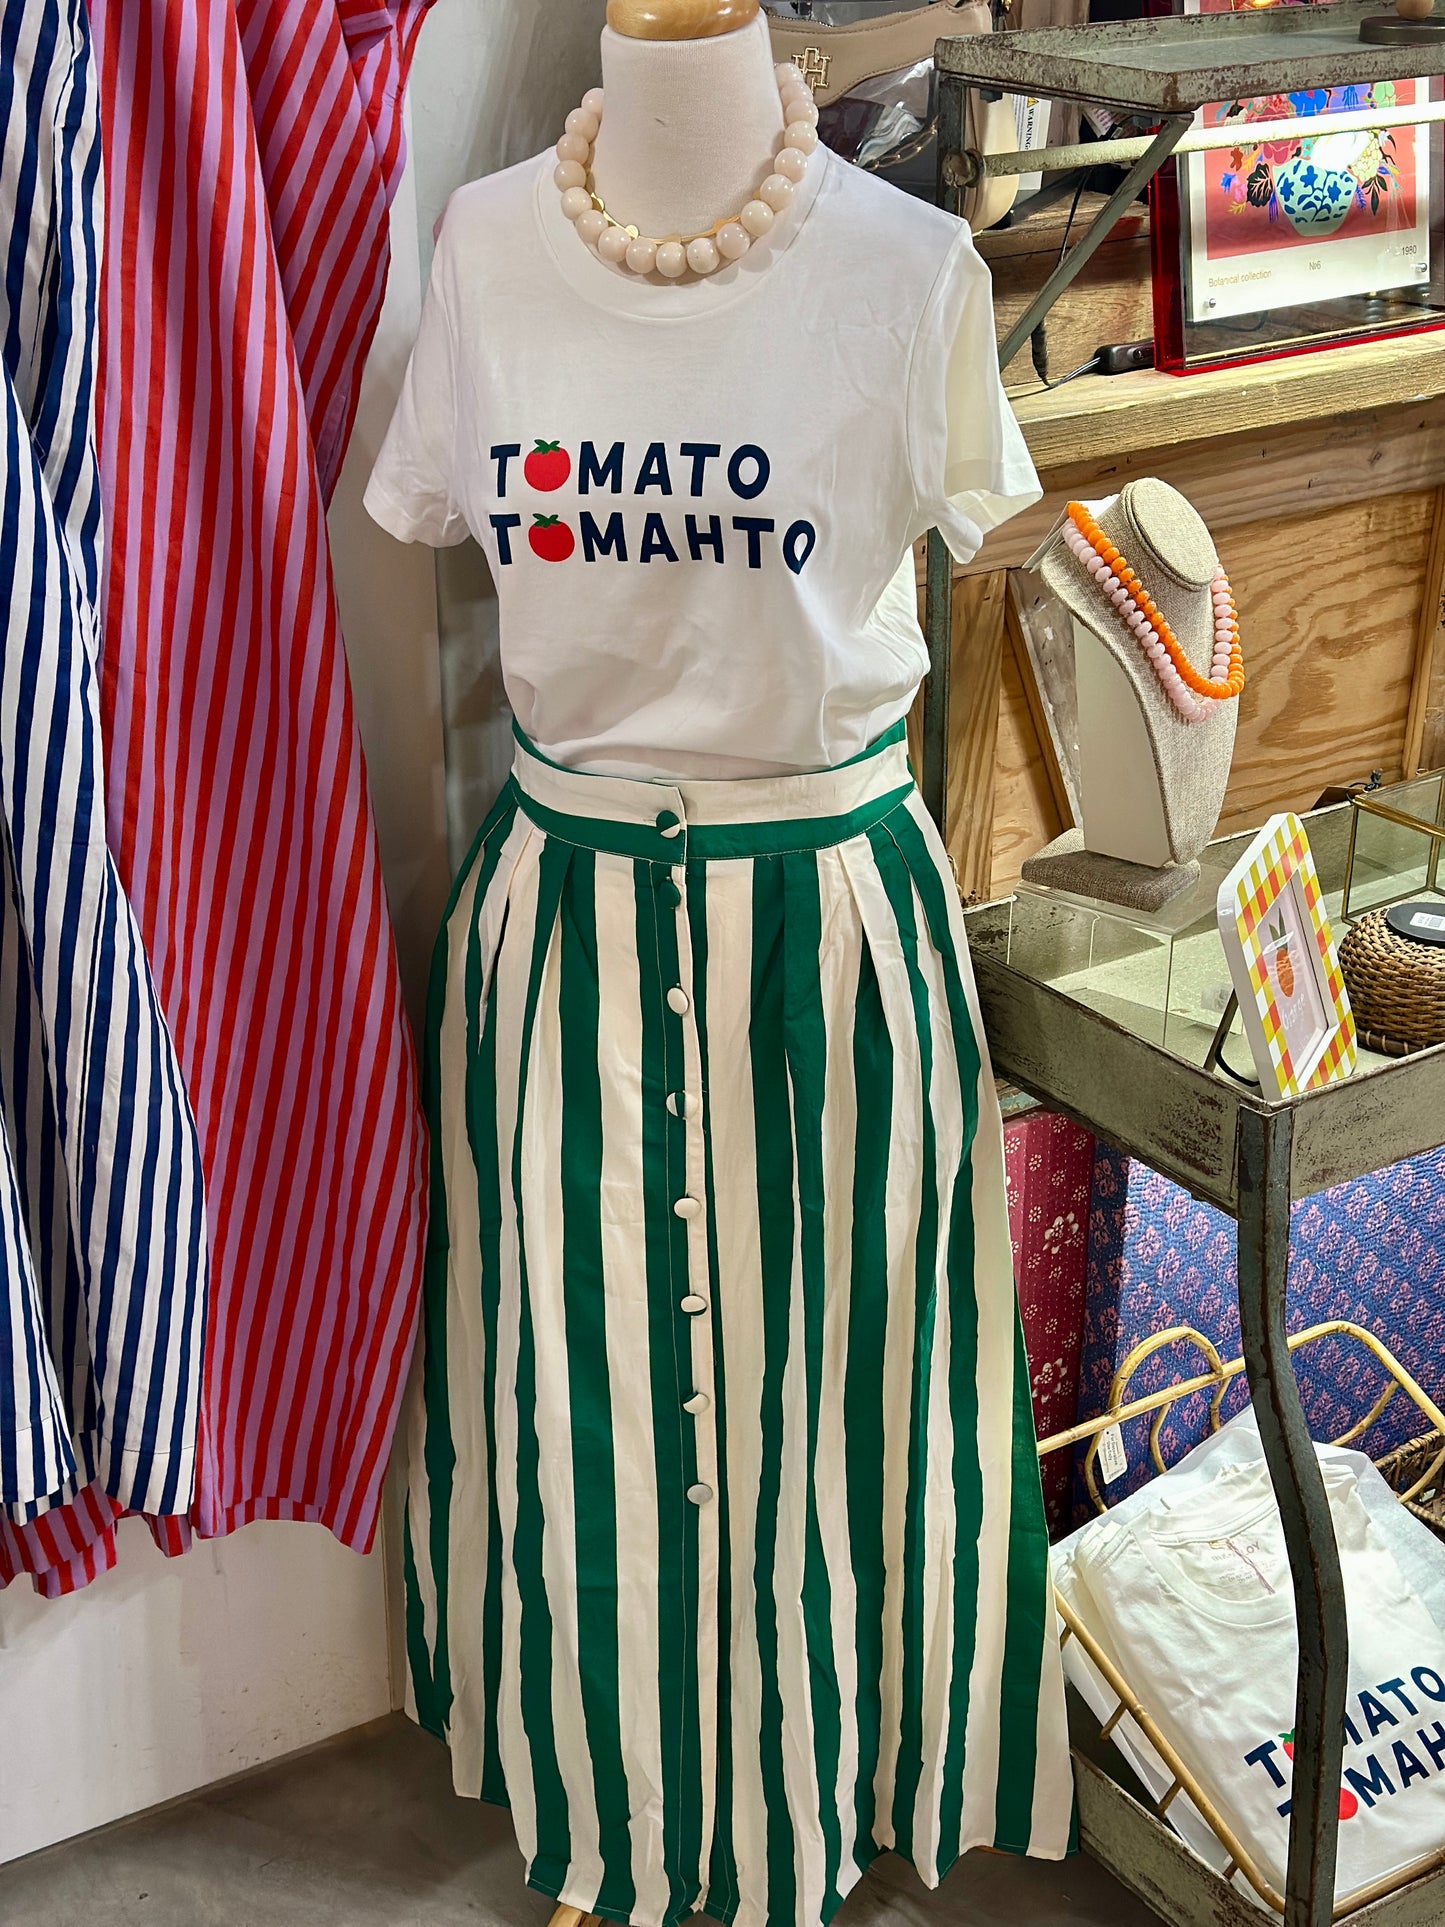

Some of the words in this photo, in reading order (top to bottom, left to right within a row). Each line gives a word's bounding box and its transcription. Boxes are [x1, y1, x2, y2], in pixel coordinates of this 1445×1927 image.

[1208, 274, 1240, 287] Botanical
[1241, 270, 1272, 282] collection
[490, 439, 770, 500] TOMATO
[489, 511, 816, 575] TOMAHTO
